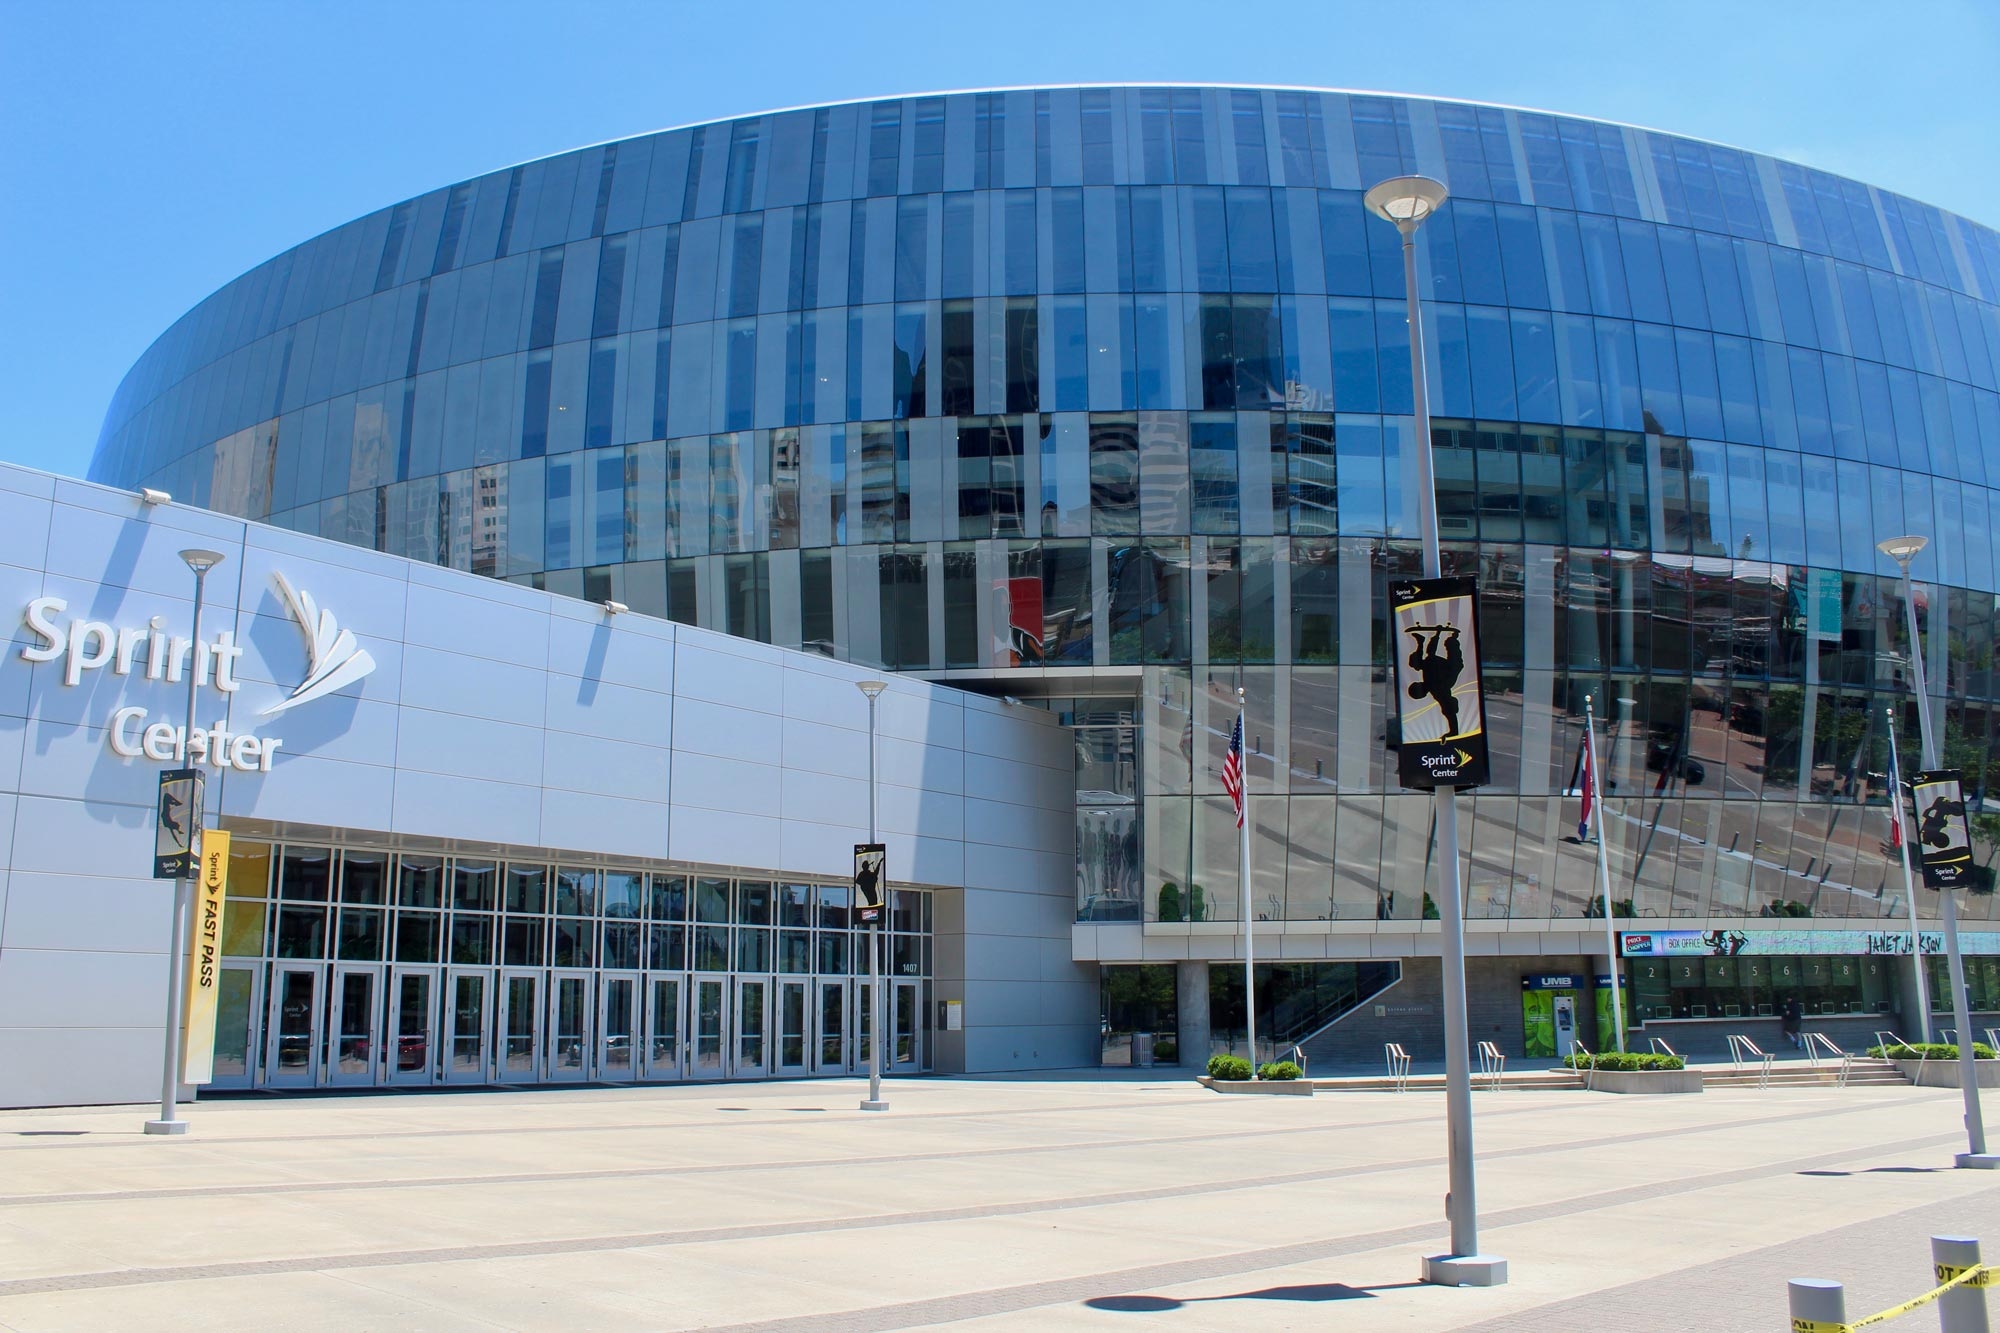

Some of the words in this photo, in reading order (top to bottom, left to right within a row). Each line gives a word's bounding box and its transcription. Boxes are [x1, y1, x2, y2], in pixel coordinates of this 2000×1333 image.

[21, 596, 243, 692] Sprint
[110, 706, 283, 772] Center
[1421, 754, 1456, 768] Sprint
[1432, 769, 1459, 777] Center
[208, 852, 220, 881] Sprint
[203, 899, 218, 941] FAST
[1668, 938, 1680, 949] BOX
[1682, 938, 1701, 949] OFFICE
[1865, 930, 1901, 955] JANET
[1901, 932, 1942, 954] JAKSON
[200, 944, 215, 988] PASS
[903, 963, 917, 973] 1407
[1684, 966, 1691, 977] 3
[1718, 966, 1725, 976] 4
[1752, 965, 1758, 976] 5
[1783, 965, 1790, 976] 6
[1813, 965, 1819, 975] 7
[1843, 965, 1849, 975] 8
[1870, 965, 1876, 975] 9
[1648, 967, 1655, 978] 2
[1541, 977, 1573, 986] UMB
